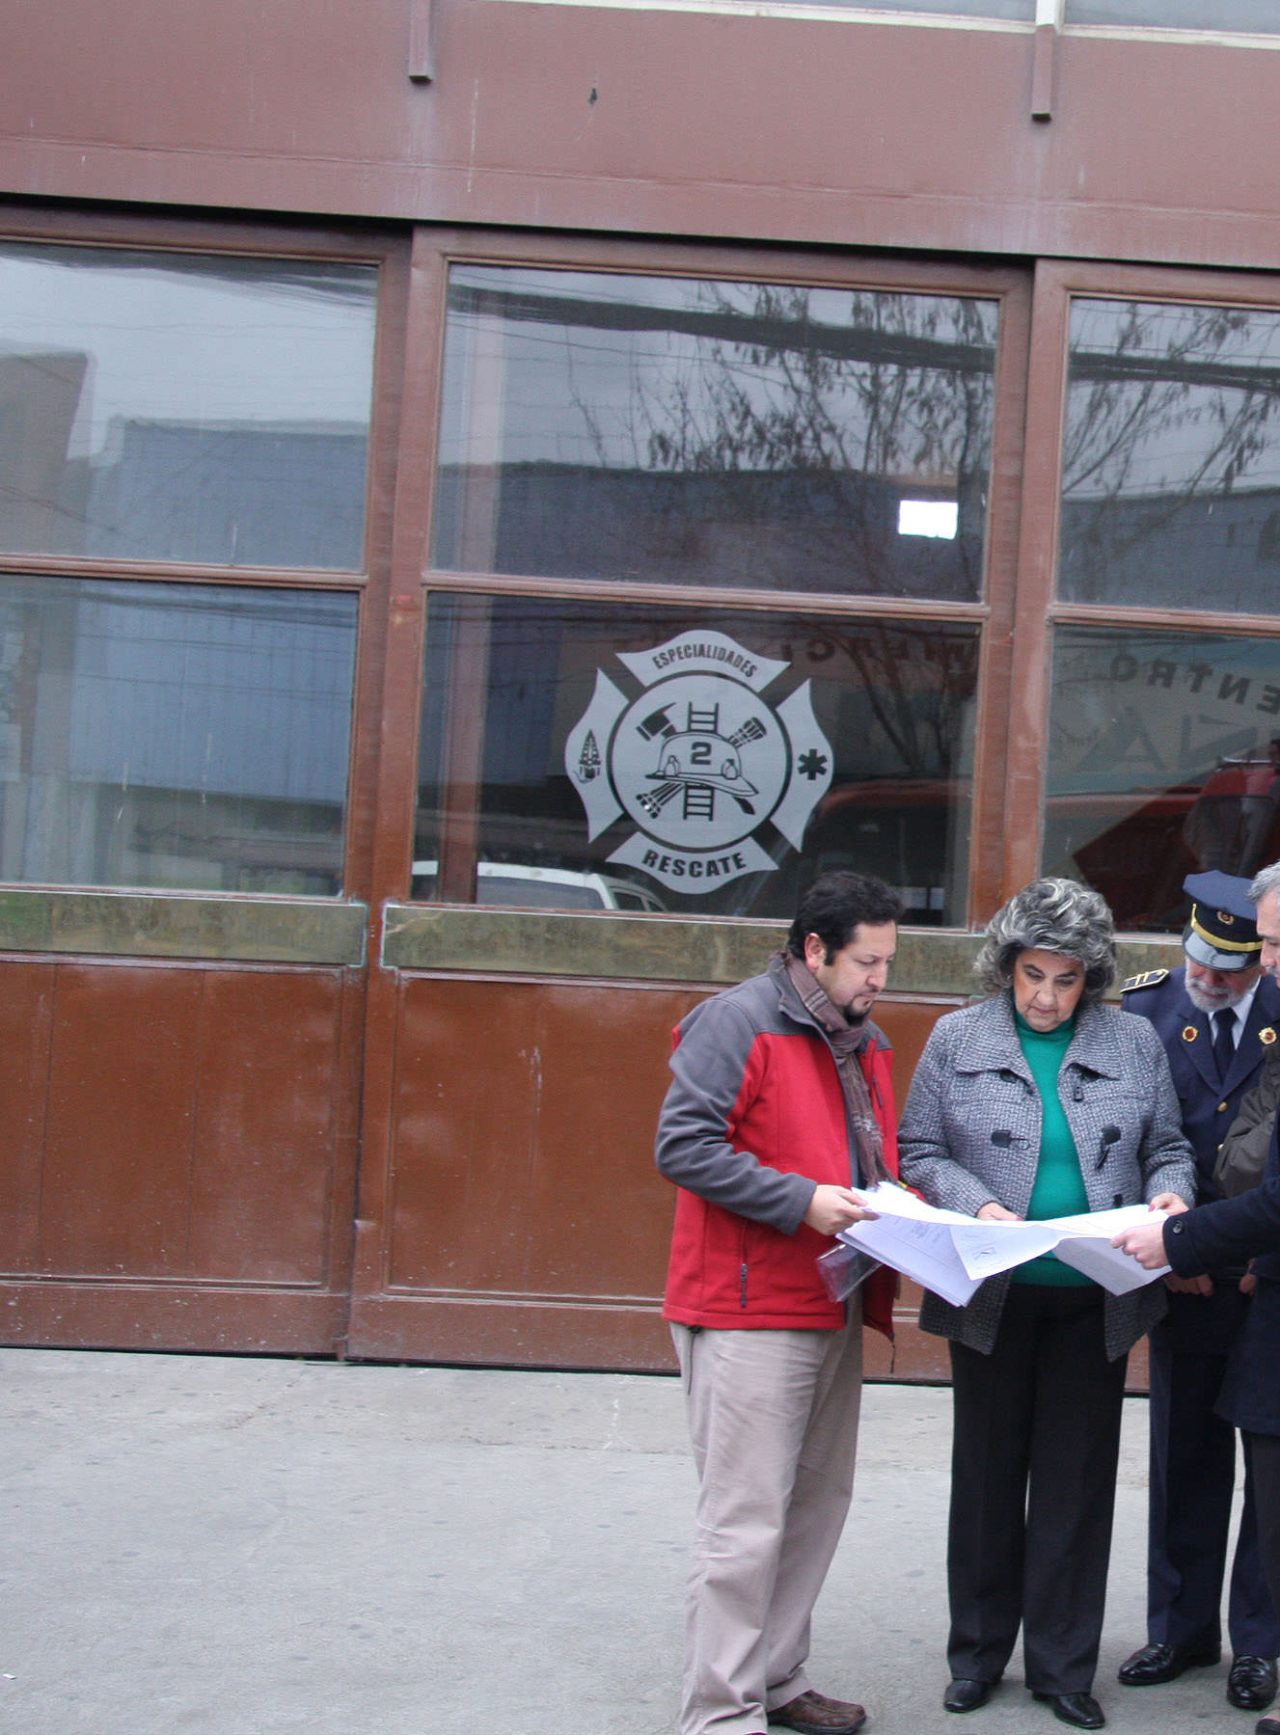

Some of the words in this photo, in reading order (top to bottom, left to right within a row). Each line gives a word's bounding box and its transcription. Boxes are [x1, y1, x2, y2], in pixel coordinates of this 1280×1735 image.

[653, 643, 757, 678] ESPECIALIDADES
[690, 742, 712, 765] 2
[642, 849, 747, 878] RESCATE
